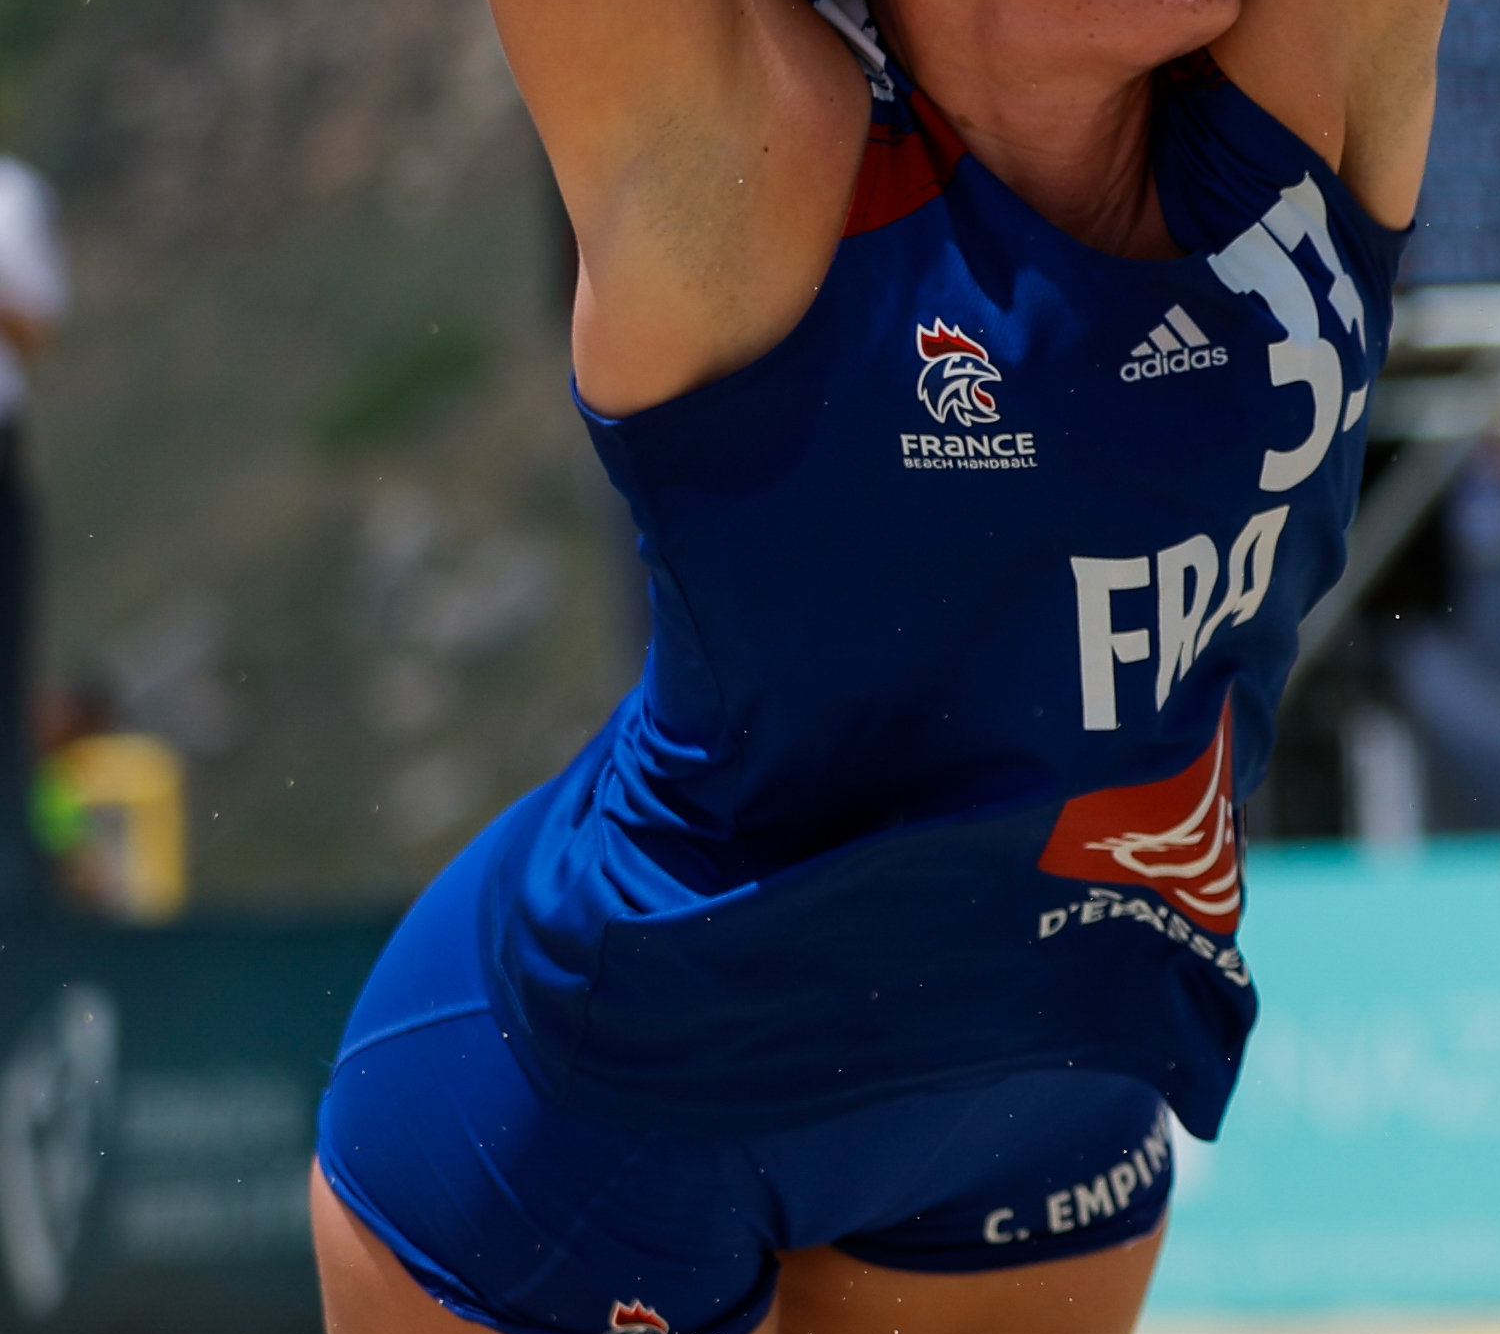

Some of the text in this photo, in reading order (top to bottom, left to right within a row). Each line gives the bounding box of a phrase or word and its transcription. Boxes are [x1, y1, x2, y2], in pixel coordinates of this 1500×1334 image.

[1120, 347, 1229, 383] adidas
[1070, 504, 1290, 731] FRA
[983, 1100, 1169, 1244] C. EMPIN
